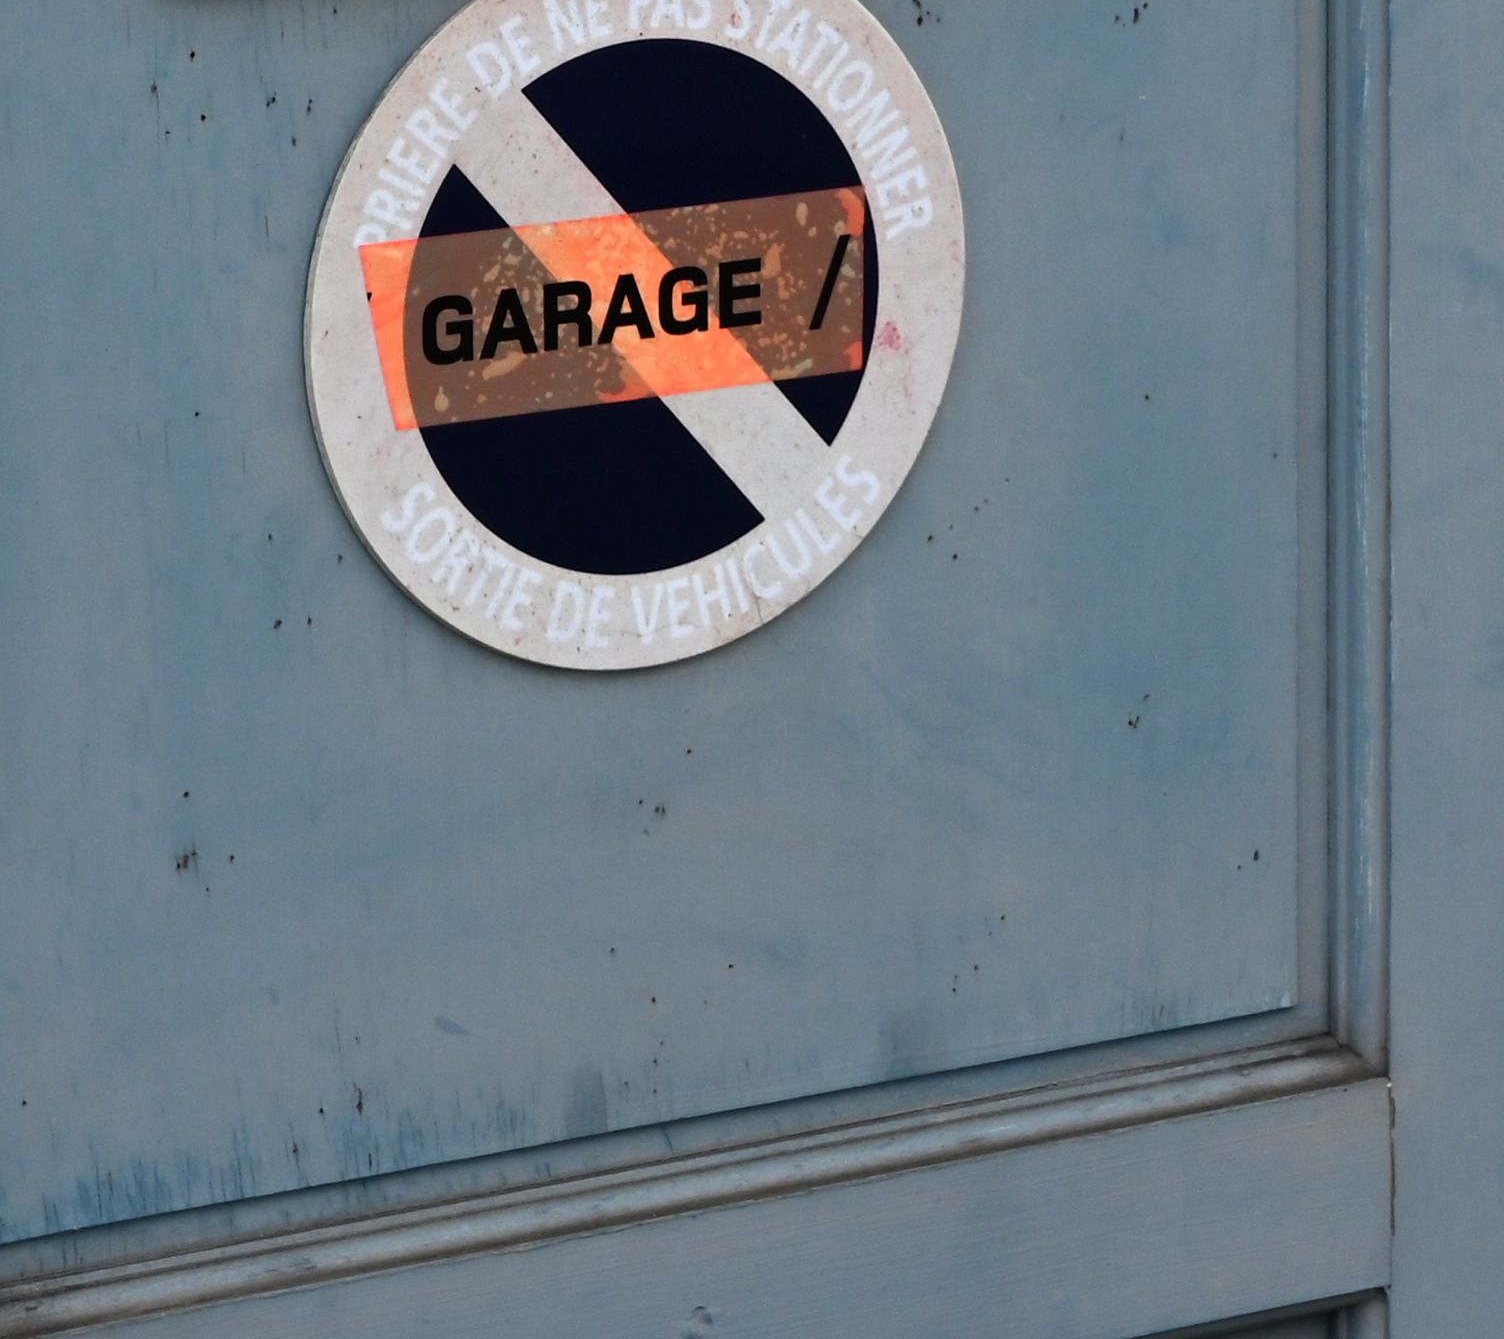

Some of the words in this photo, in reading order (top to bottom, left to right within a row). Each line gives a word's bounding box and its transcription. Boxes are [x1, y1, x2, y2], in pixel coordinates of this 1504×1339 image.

[466, 13, 541, 96] DE
[421, 257, 764, 367] GARAGE
[380, 481, 544, 625] SORTIE
[546, 579, 617, 648] DE
[630, 454, 882, 642] VEHICULES
